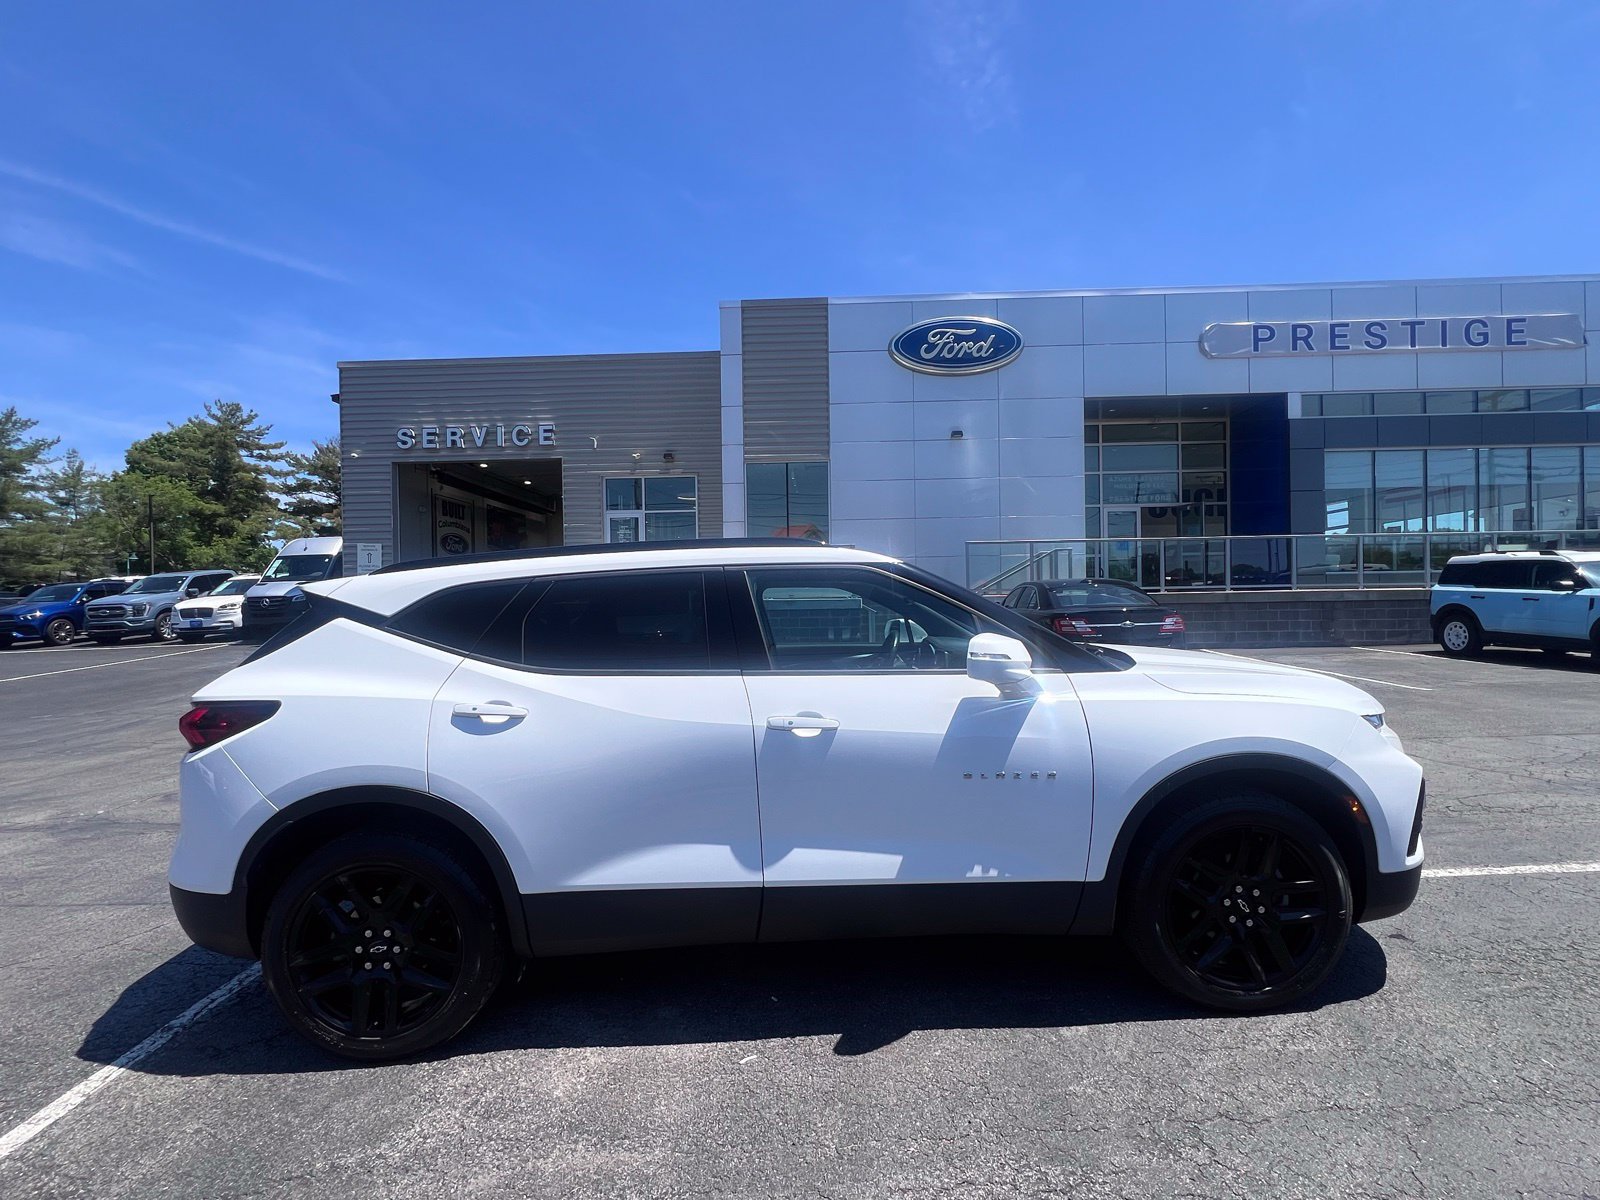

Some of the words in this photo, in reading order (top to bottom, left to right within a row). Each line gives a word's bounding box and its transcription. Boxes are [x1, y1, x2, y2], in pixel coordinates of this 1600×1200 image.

[920, 328, 996, 359] Ford
[1251, 317, 1529, 353] PRESTIGE
[396, 423, 556, 450] SERVICE
[441, 500, 466, 520] BUILT
[963, 770, 1057, 780] BLAZER
